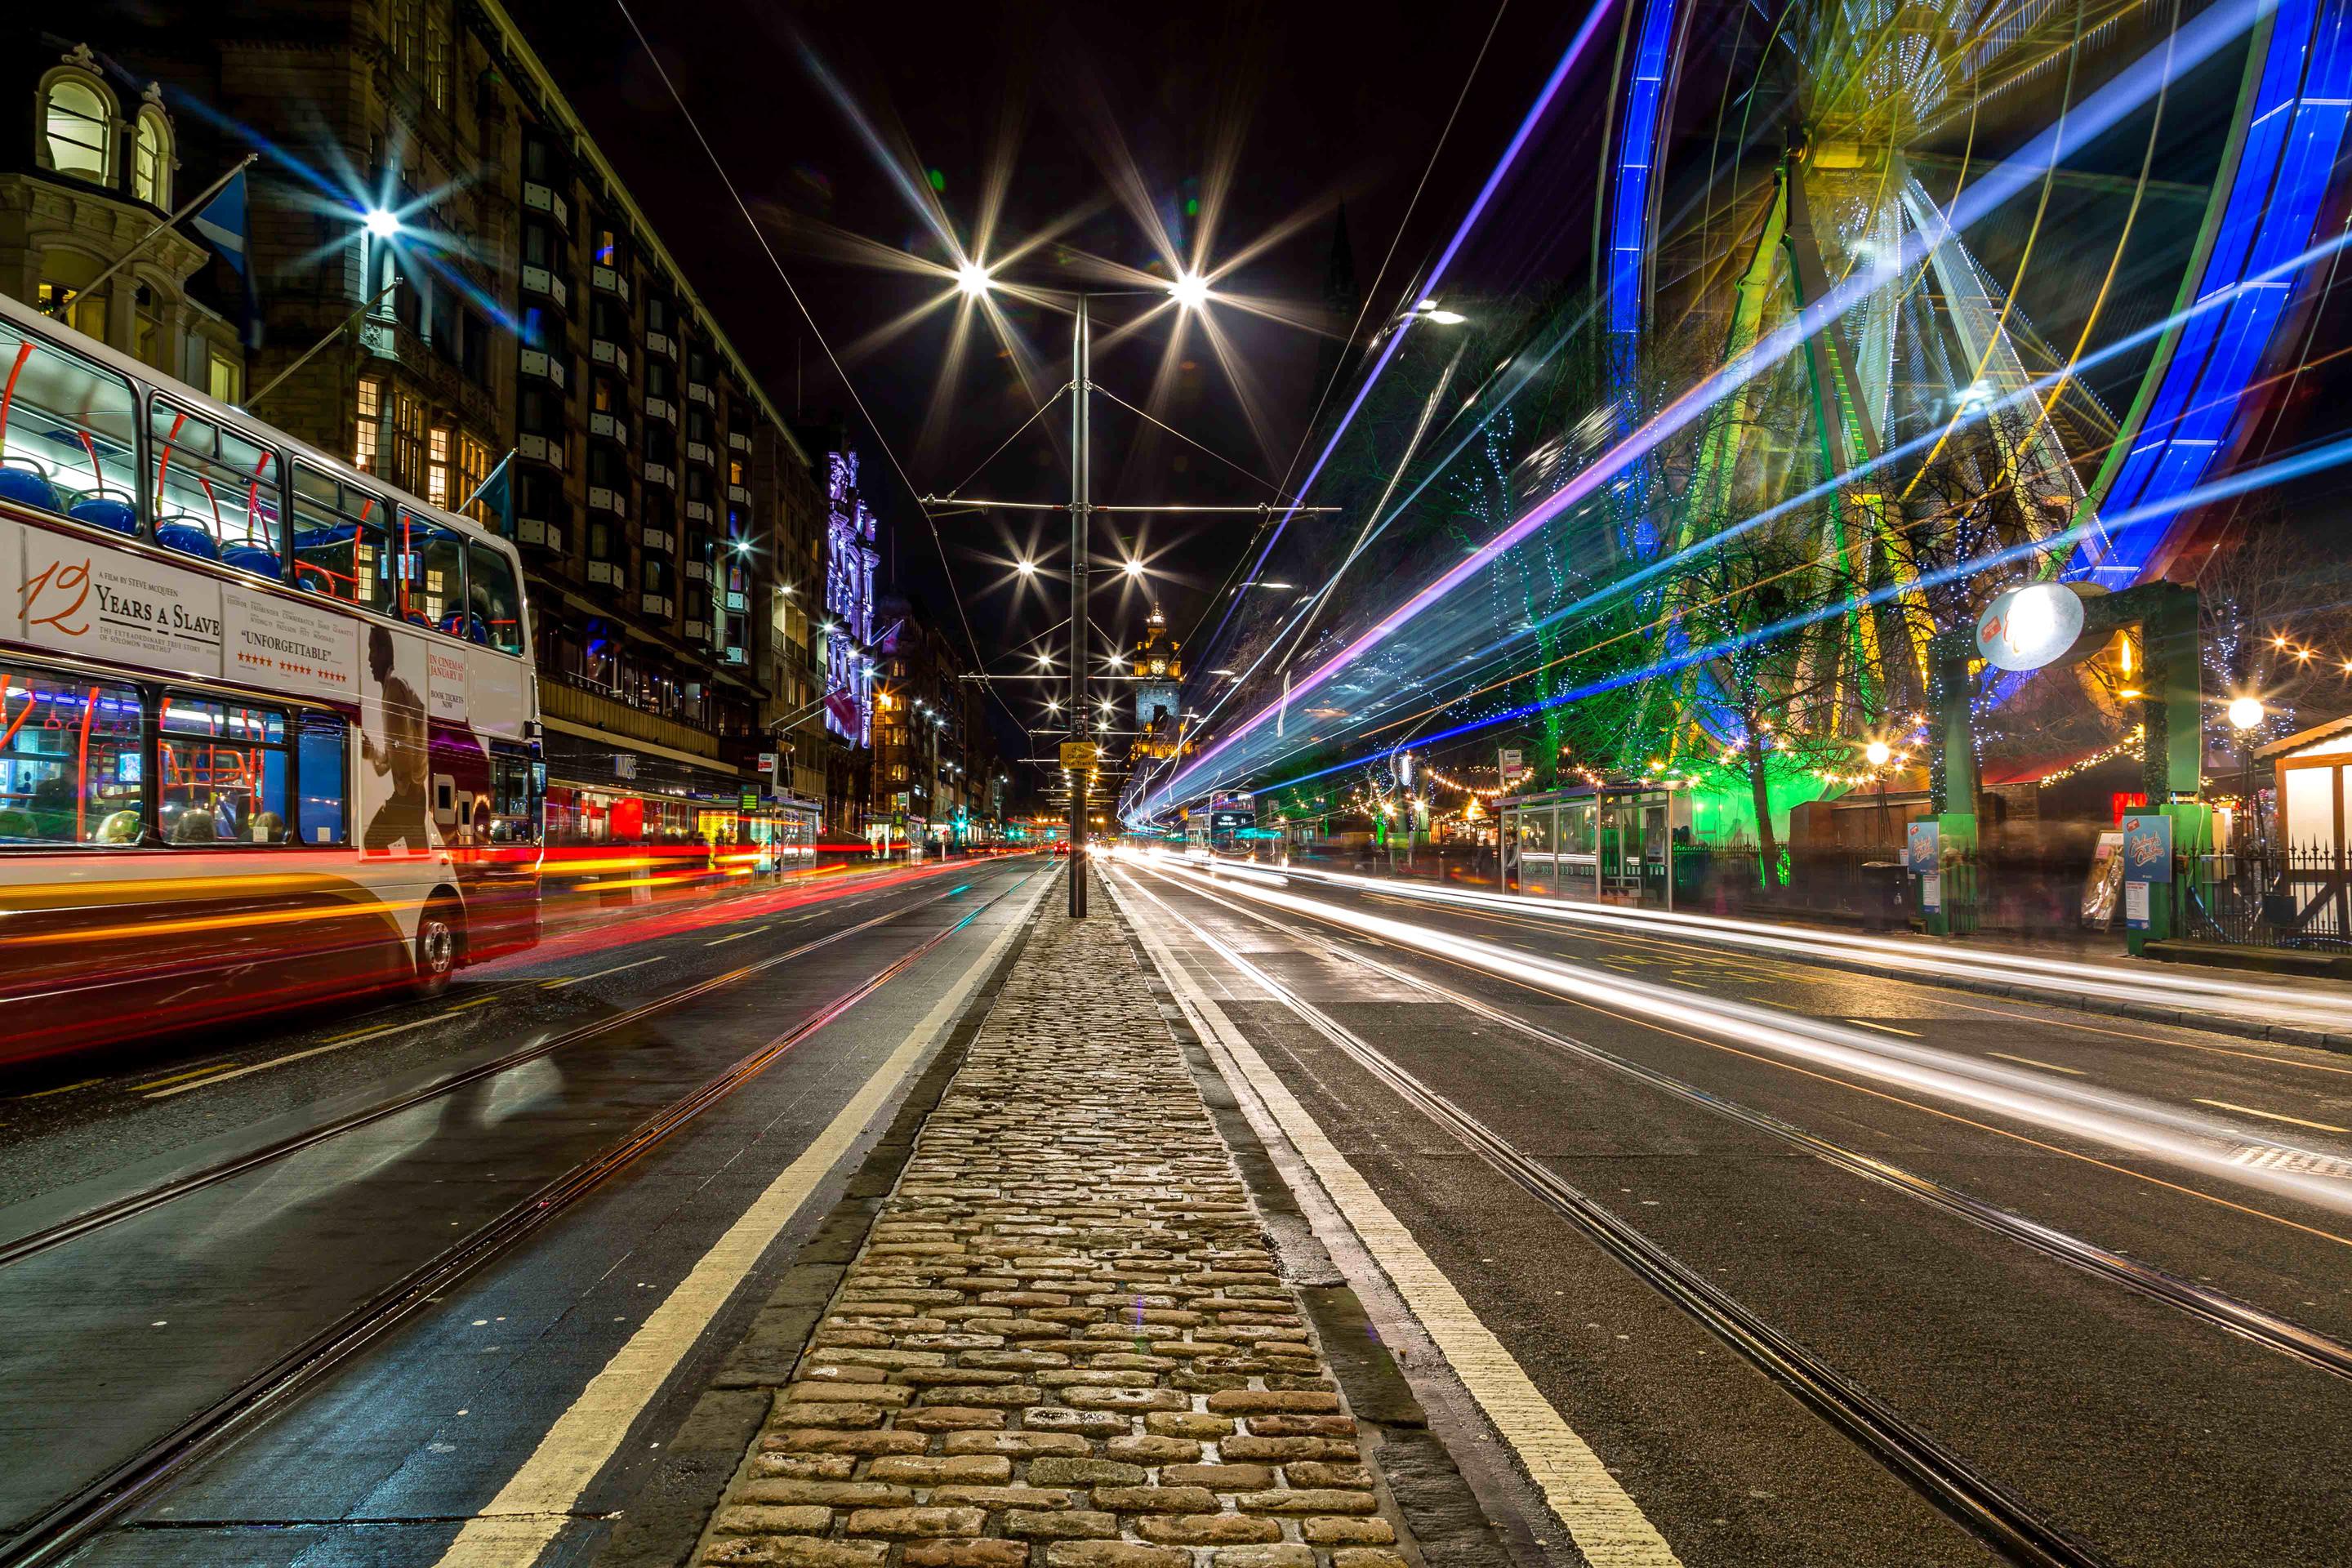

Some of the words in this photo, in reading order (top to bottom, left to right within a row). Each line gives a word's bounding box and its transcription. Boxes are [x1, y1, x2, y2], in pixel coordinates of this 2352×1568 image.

[105, 572, 118, 582] FILM
[128, 578, 147, 590] STEVE
[17, 557, 91, 636] 12
[156, 606, 169, 626] A
[100, 626, 113, 635] THE
[114, 629, 165, 646] EXTRAORDINARY
[167, 640, 181, 649] TRUE
[183, 644, 201, 653] STORY
[110, 636, 141, 648] SOLOMON
[430, 654, 438, 665] IN
[439, 657, 464, 672] CINEMAS
[431, 666, 457, 680] JANUARY
[431, 690, 444, 700] BOOK
[445, 693, 464, 704] TICKETS
[442, 700, 452, 709] NOW
